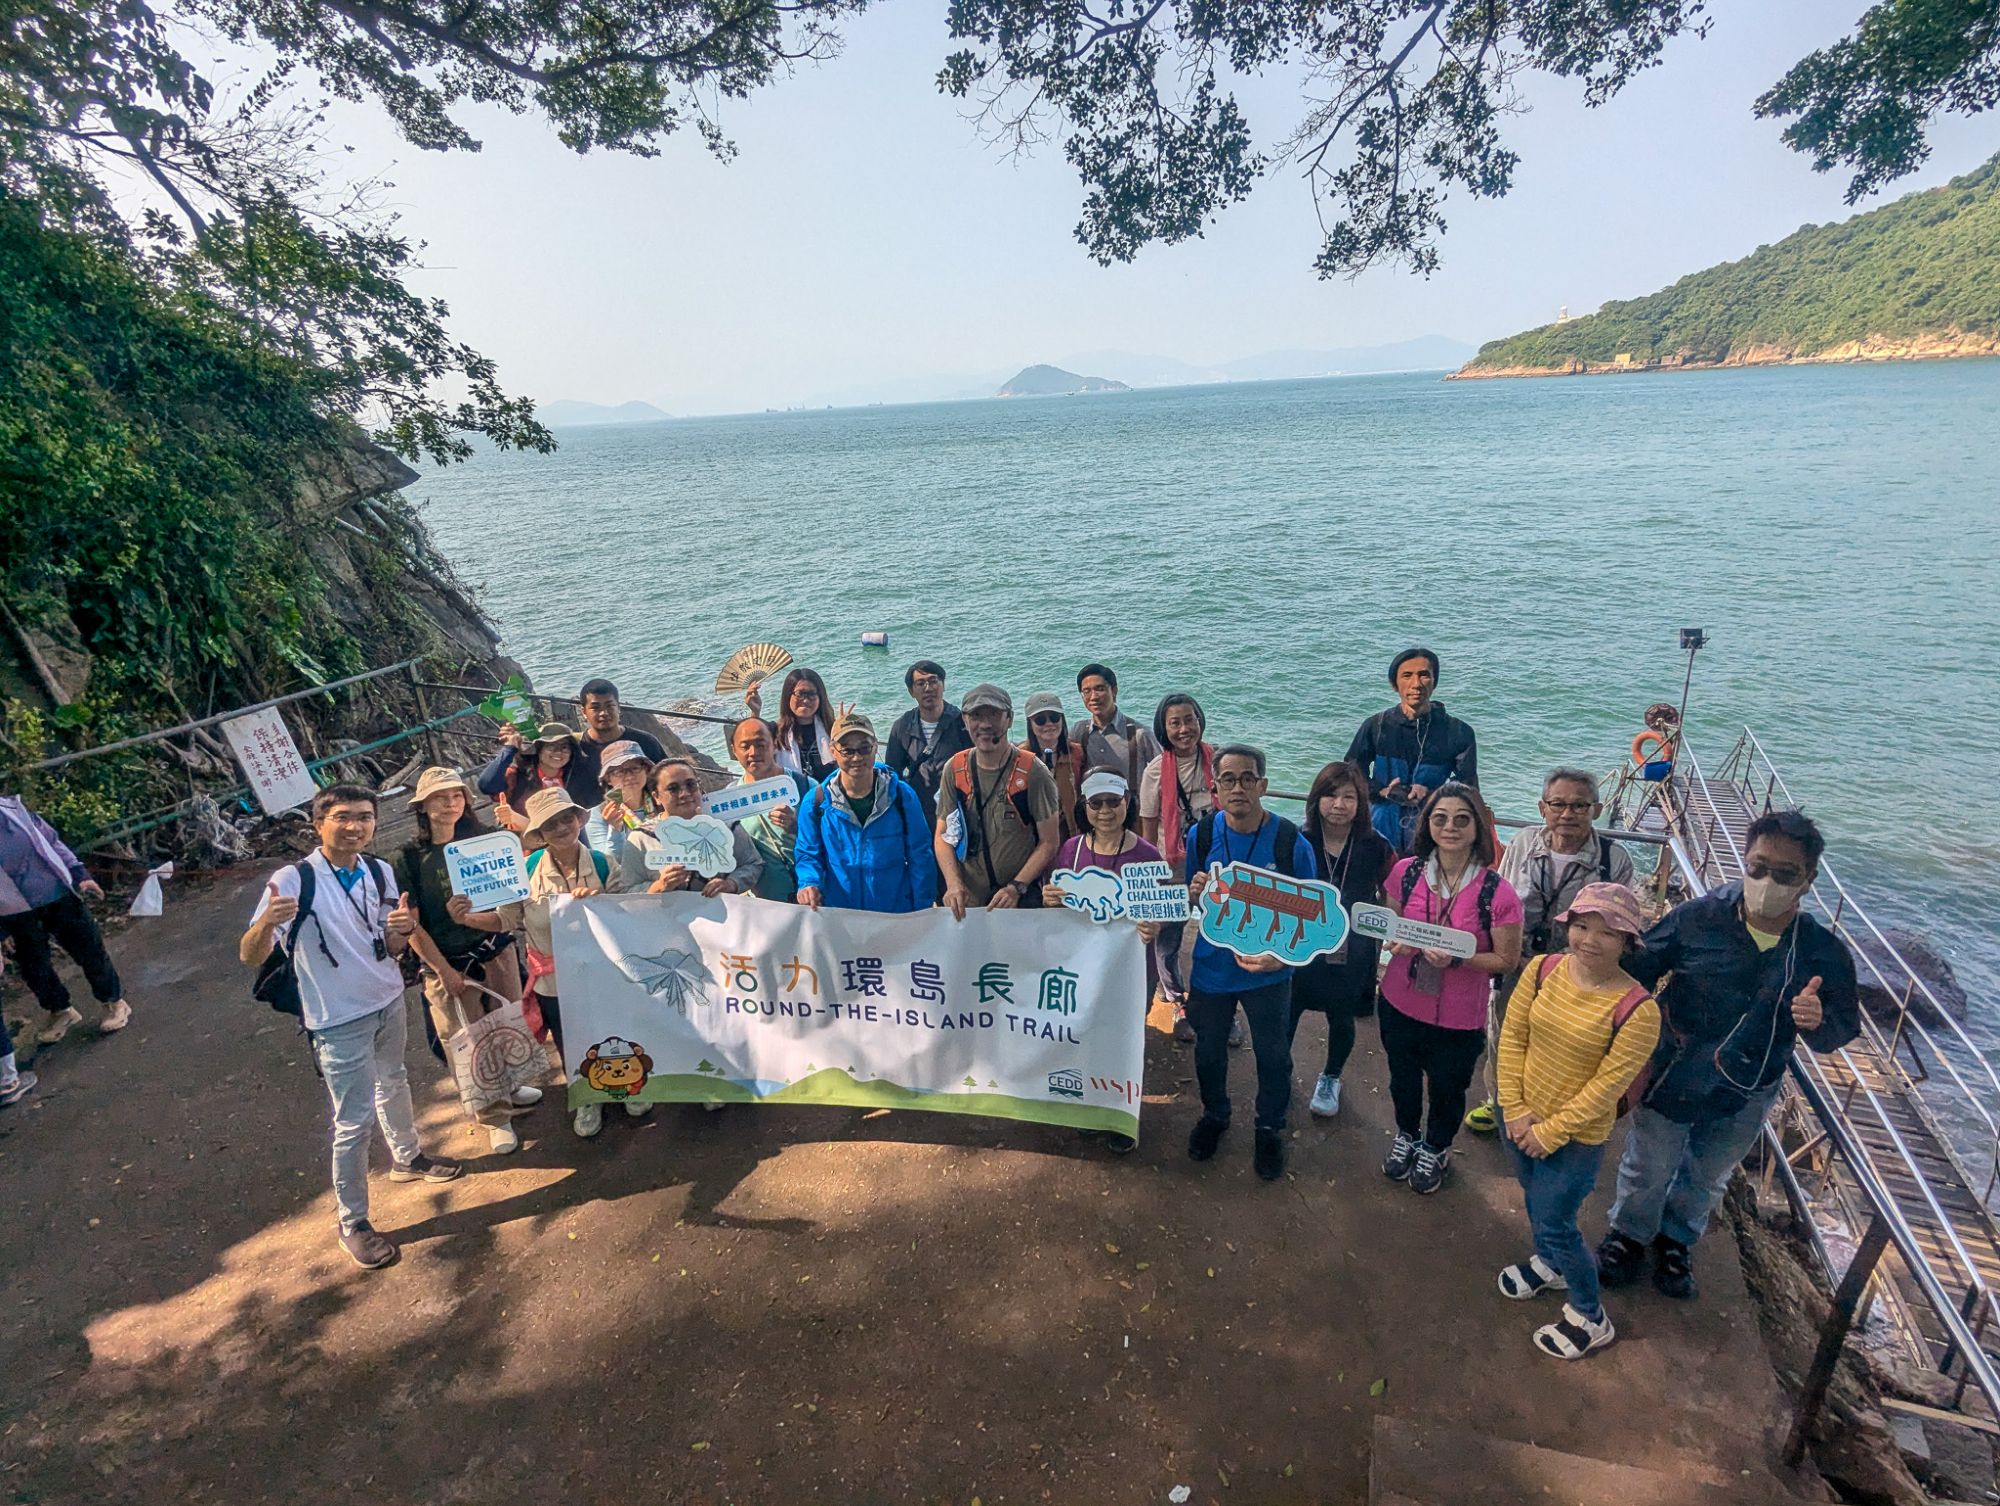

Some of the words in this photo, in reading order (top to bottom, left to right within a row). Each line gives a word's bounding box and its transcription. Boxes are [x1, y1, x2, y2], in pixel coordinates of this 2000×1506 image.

[457, 851, 495, 866] CONNECT
[501, 847, 512, 855] TO
[460, 855, 516, 879] NATURE
[1124, 865, 1169, 878] COASTAL
[462, 873, 500, 887] CONNECT
[507, 868, 518, 876] TO
[464, 885, 483, 896] THE
[484, 876, 519, 892] FUTURE
[1126, 879, 1156, 890] TRAIL
[1127, 888, 1187, 902] CHALLENGE
[1129, 902, 1187, 919] 環島徑挑戰
[1357, 915, 1388, 928] CEDD
[720, 952, 1079, 1016] 活力環島長廊
[726, 997, 994, 1030] ROUND-THE-ISLAND
[1006, 1013, 1081, 1044] TRAIL
[1048, 1075, 1083, 1090] CEDD
